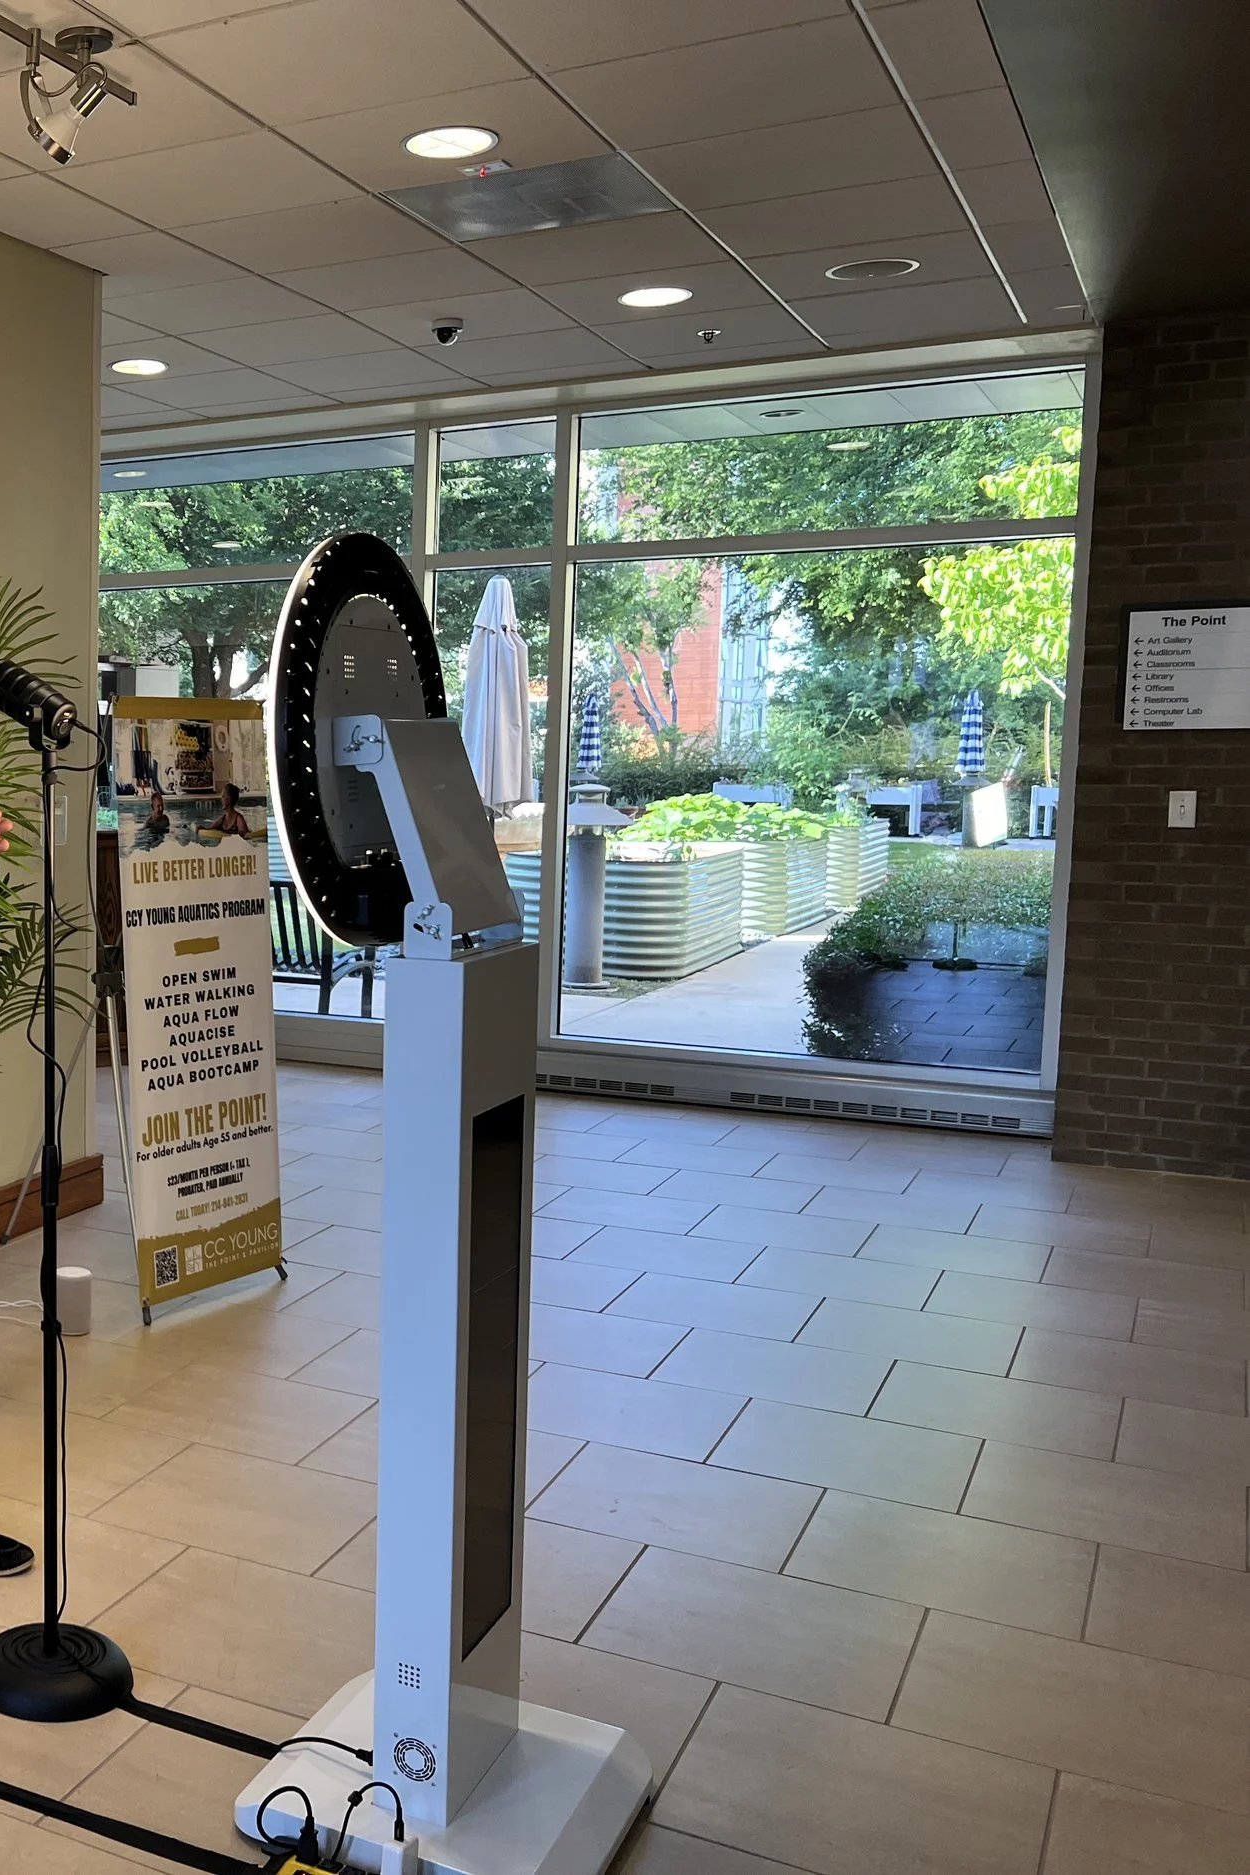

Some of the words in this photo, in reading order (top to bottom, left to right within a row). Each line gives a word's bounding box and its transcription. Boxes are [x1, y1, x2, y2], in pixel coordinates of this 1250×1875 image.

[1162, 616, 1187, 627] The
[1191, 615, 1226, 626] Point
[1147, 637, 1161, 645] Art
[1163, 636, 1193, 645] Gallery
[1146, 660, 1195, 668] Classrooms
[1145, 673, 1174, 681] Library
[1144, 684, 1175, 692] Offices
[1144, 696, 1189, 704] Restrooms
[1143, 708, 1184, 716] Computer
[1186, 707, 1203, 715] Lab
[133, 861, 159, 884] LIVE
[163, 858, 205, 882] BETTER
[208, 854, 257, 878] LONGER!
[126, 909, 143, 928] CCY
[146, 906, 176, 926] YOUNG
[178, 902, 220, 923] AQUATICS
[222, 898, 265, 918] PROGRAM
[162, 972, 197, 987] OPEN
[202, 967, 236, 982] SWIM
[144, 993, 190, 1010] WATER
[195, 984, 255, 1003] WALKING
[163, 1011, 199, 1028] AQUA
[204, 1005, 239, 1021] FLOW
[169, 1025, 235, 1047] AQUACISE
[141, 1055, 176, 1072] POOL
[182, 1040, 263, 1064] VOLLEYBALL
[148, 1073, 184, 1091] AQUA
[189, 1059, 259, 1083] BOOTCAMP
[142, 1111, 180, 1147] JOIN
[185, 1104, 214, 1137] THE
[218, 1093, 267, 1130] POINT!
[137, 1151, 150, 1163] For
[152, 1146, 174, 1160] older
[176, 1140, 201, 1153] adults
[203, 1137, 219, 1149] Age
[220, 1132, 230, 1143] 55
[232, 1127, 247, 1140] and
[248, 1124, 274, 1137] better.
[199, 1167, 209, 1179] PER
[210, 1162, 229, 1176] PERSON
[235, 1158, 245, 1170] TAX
[205, 1178, 218, 1191] PAID
[218, 1172, 244, 1187] ANNUALLY
[175, 1207, 189, 1221] CALL
[204, 1237, 226, 1259] CC
[229, 1222, 278, 1251] YOUNG
